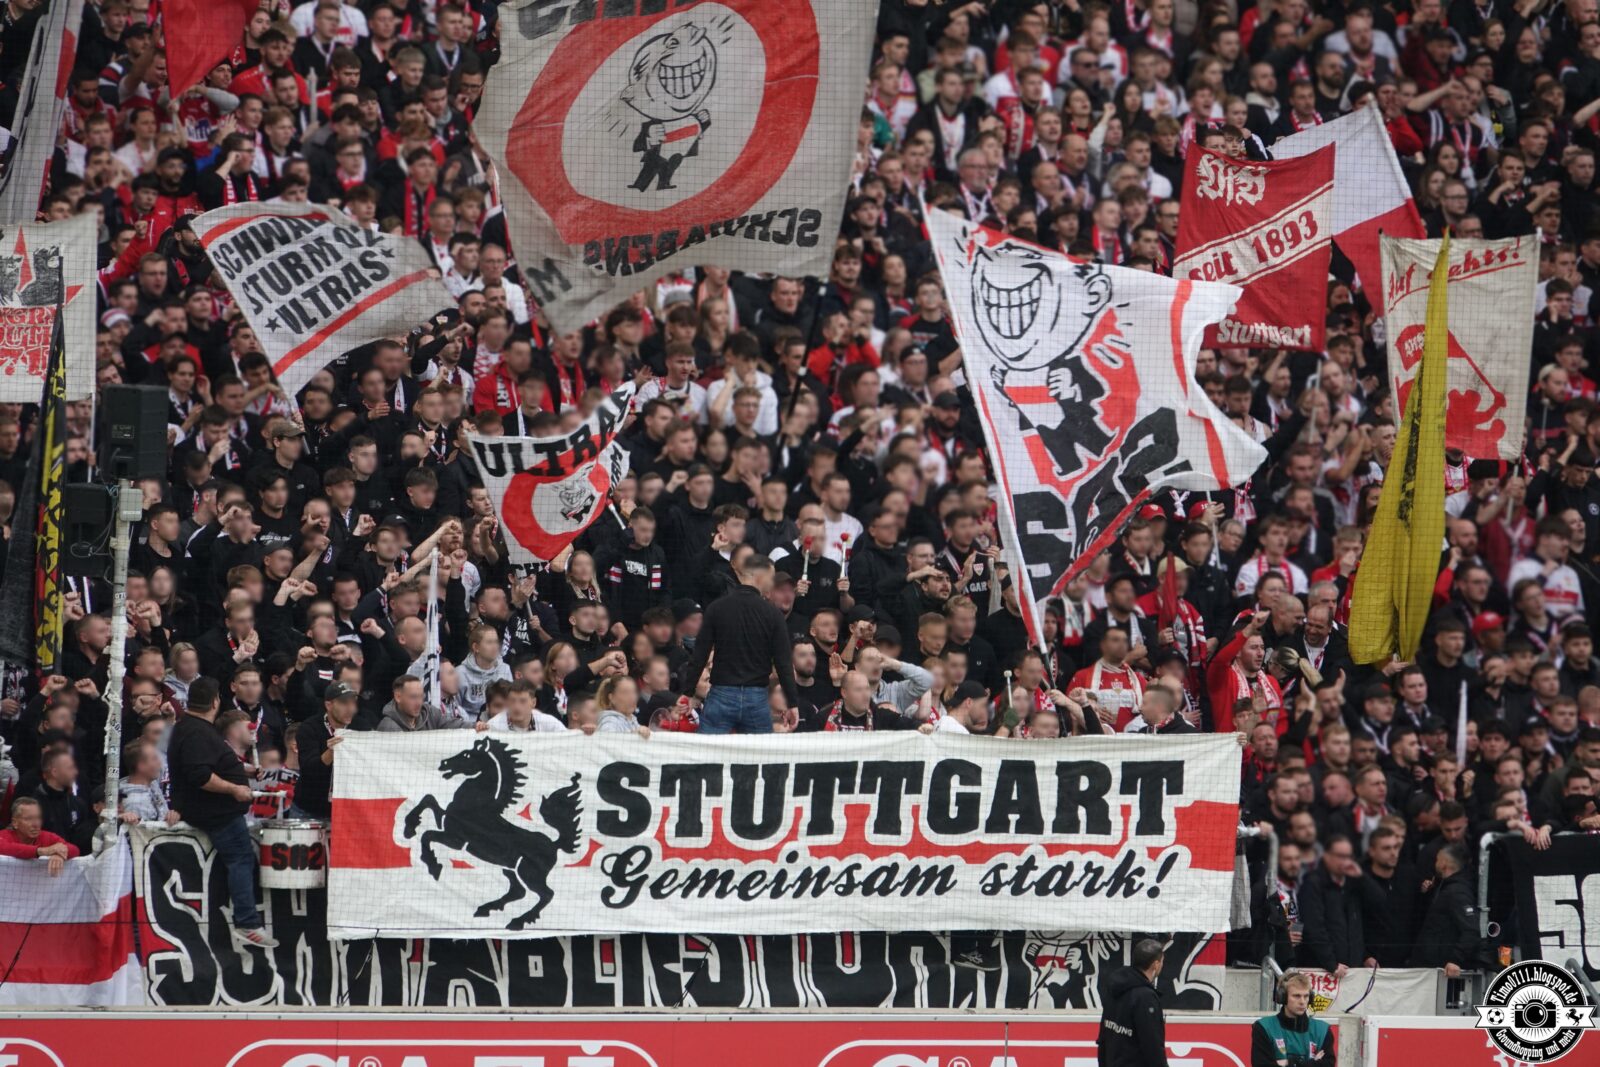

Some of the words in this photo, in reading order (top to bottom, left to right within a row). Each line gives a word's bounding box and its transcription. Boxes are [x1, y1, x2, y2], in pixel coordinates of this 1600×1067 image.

[1251, 210, 1319, 265] 1893
[242, 236, 343, 316] STURM
[1216, 319, 1312, 348] Stuttgart
[596, 758, 1185, 841] STUTTGART
[600, 844, 958, 909] Gemeinsam
[979, 848, 1180, 900] stark!
